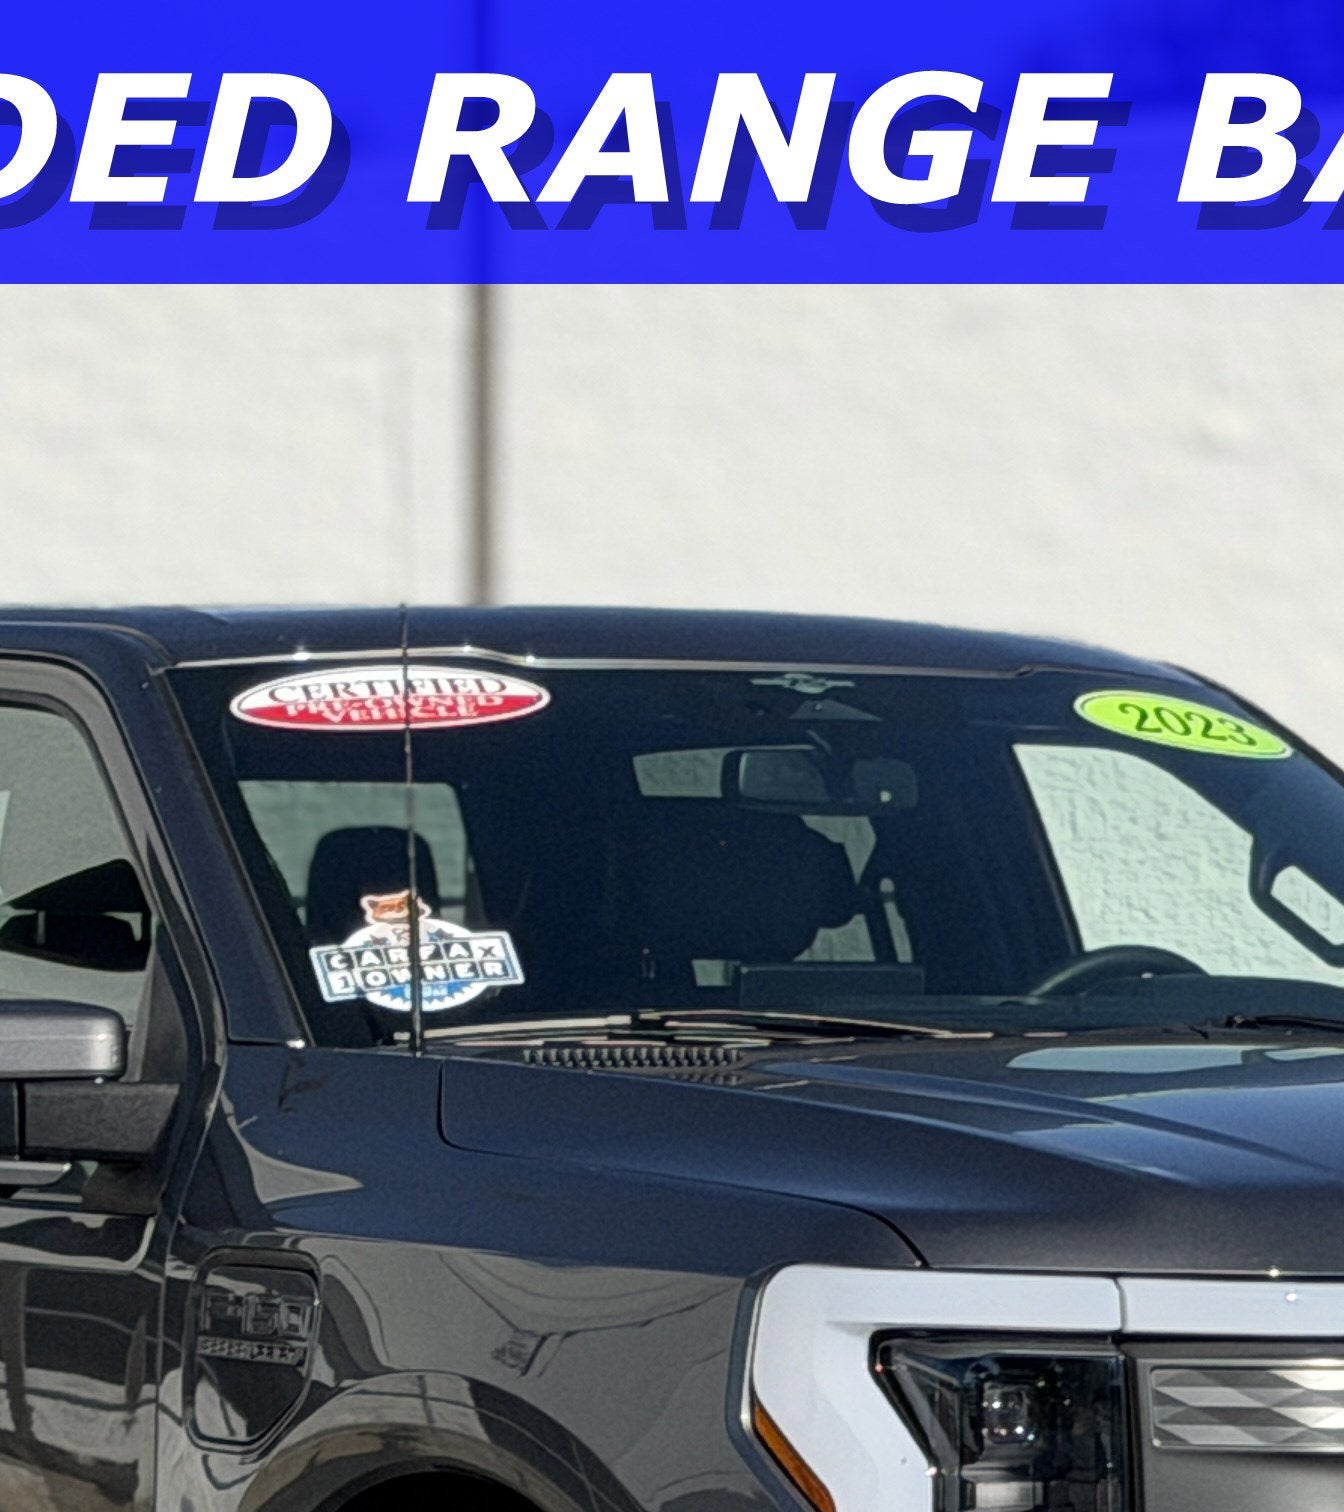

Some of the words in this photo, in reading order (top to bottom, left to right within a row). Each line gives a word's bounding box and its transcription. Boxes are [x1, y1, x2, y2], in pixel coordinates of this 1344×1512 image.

[268, 679, 507, 704] CERTIFIED
[1118, 702, 1258, 747] 2023
[329, 942, 501, 969] CARFAX
[364, 961, 504, 986] OWNER
